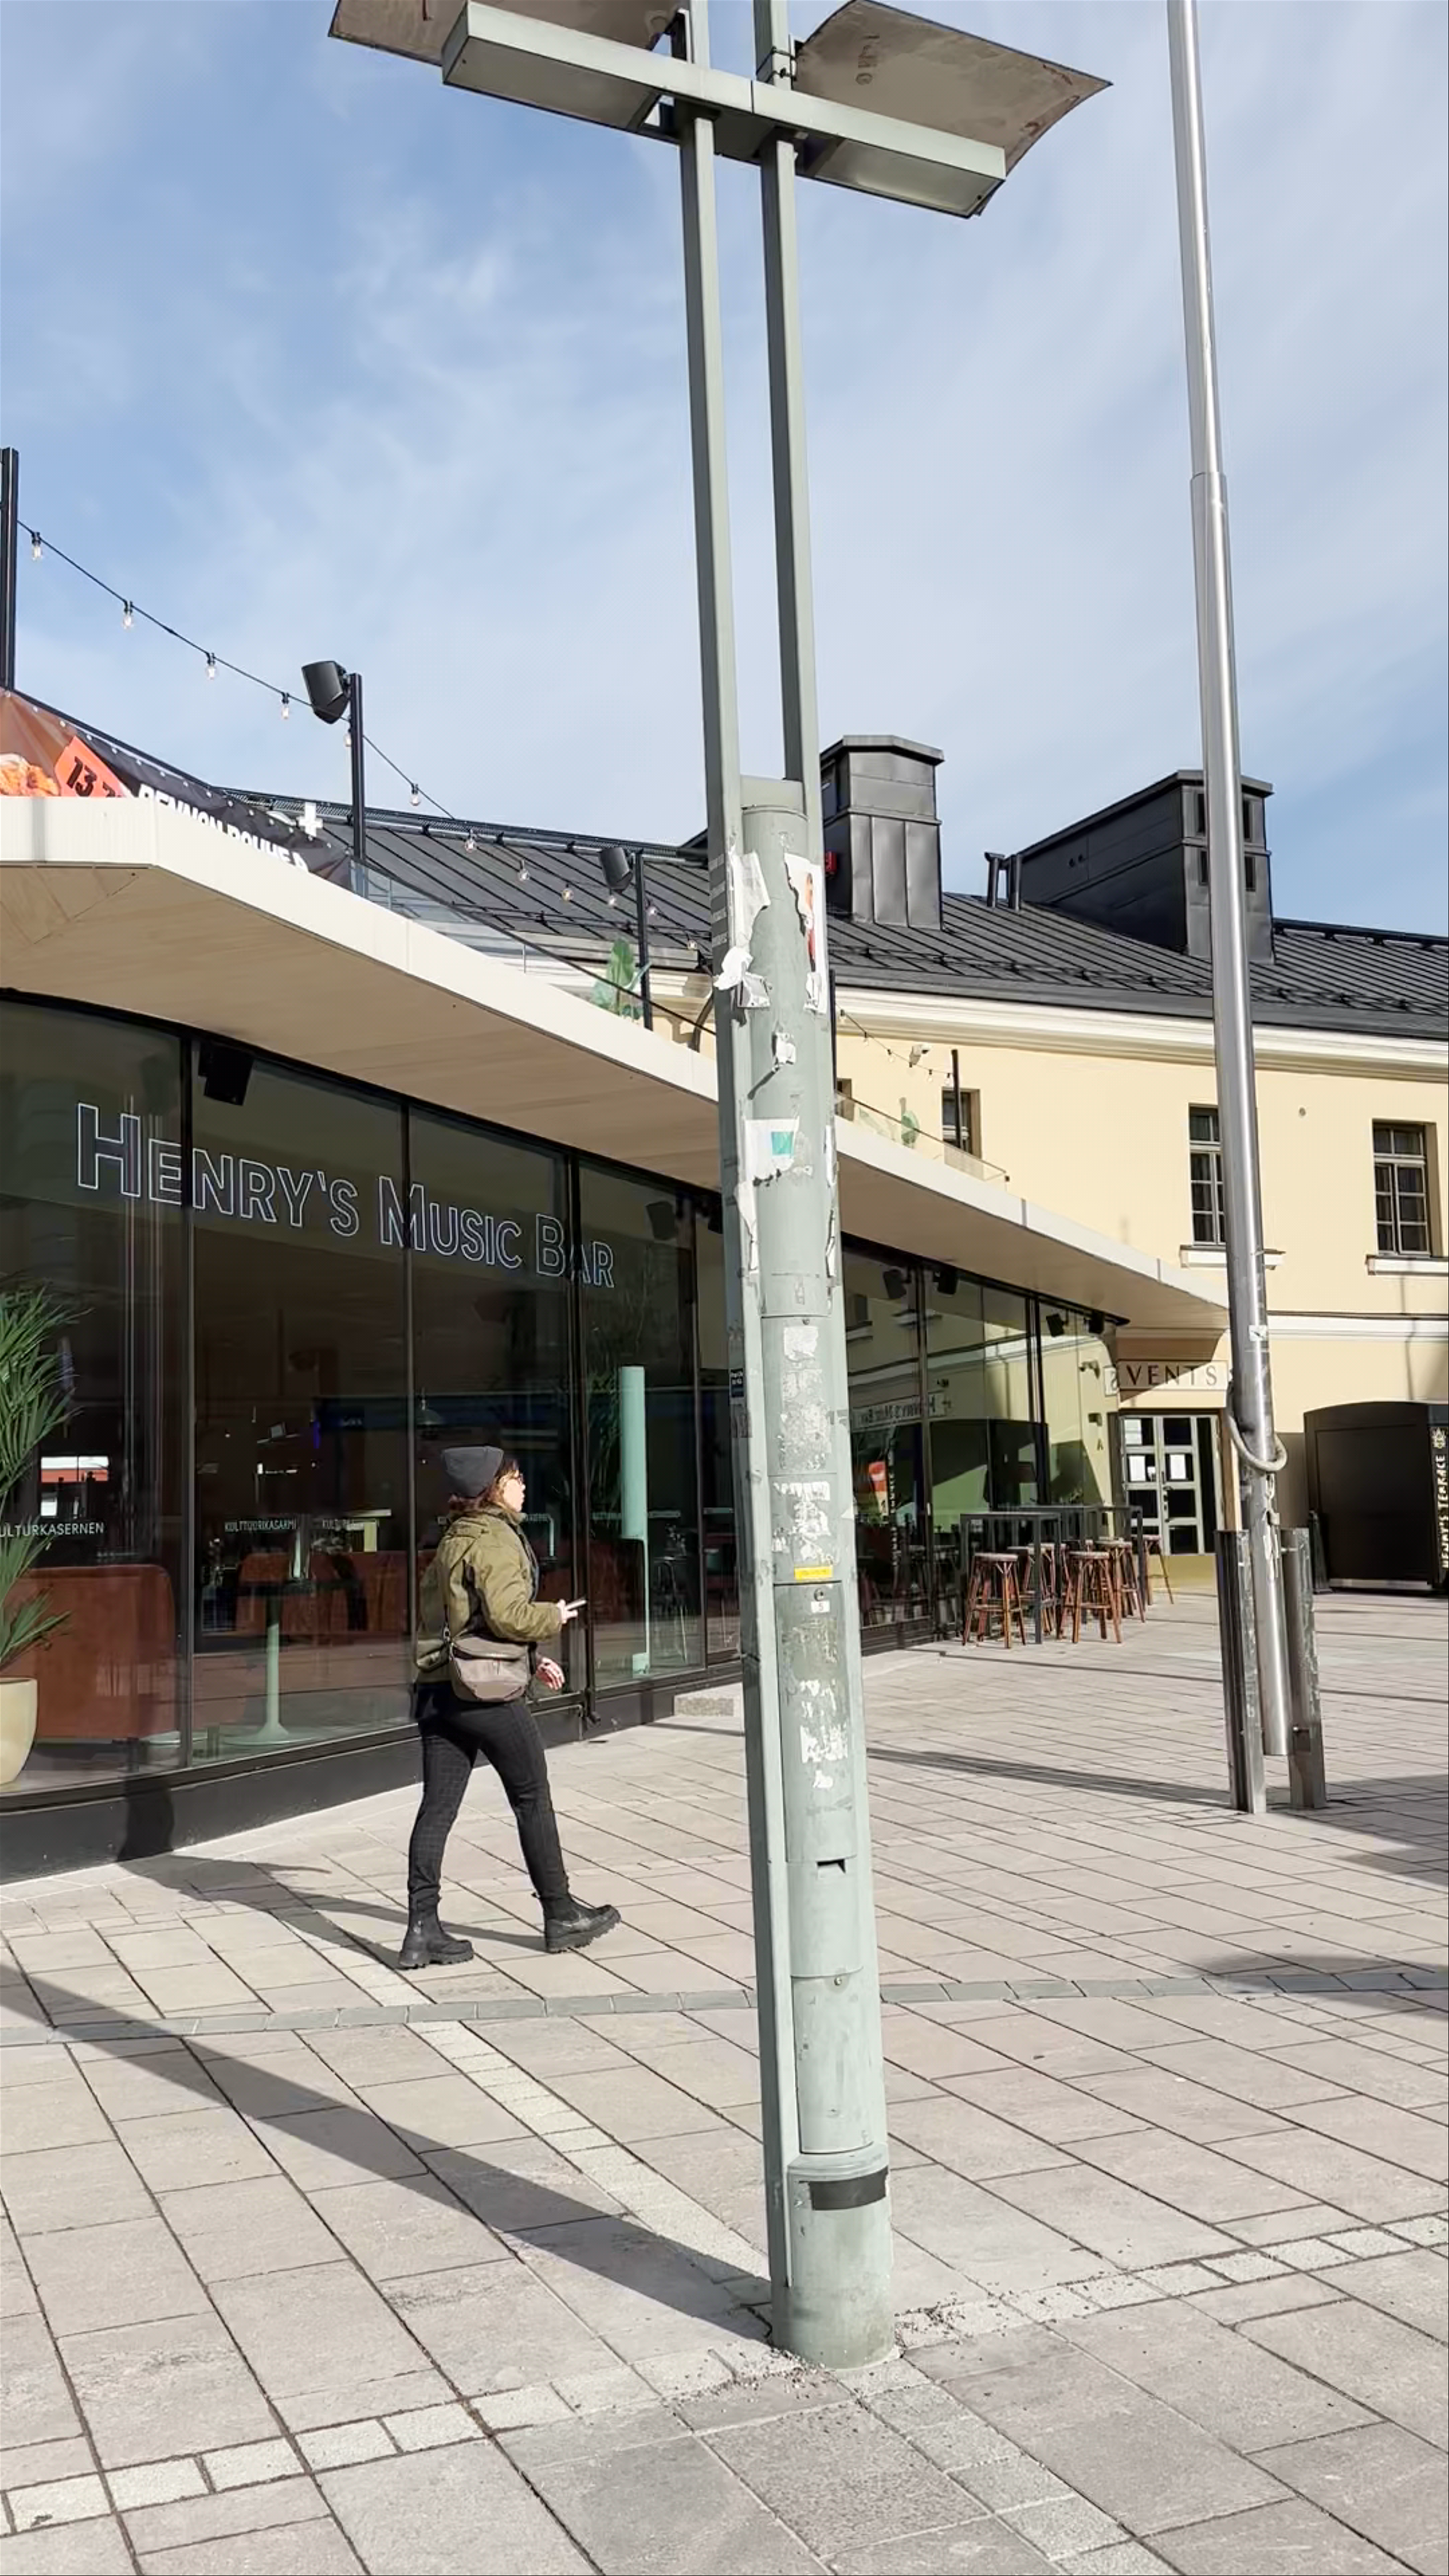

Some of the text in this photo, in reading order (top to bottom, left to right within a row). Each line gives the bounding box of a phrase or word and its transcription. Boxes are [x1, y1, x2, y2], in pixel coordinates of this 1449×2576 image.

[78, 1102, 614, 1288] HENRY'S MUSIC BAR
[1126, 1364, 1217, 1386] VENTS
[0, 1522, 105, 1538] ULTURKASERNEN
